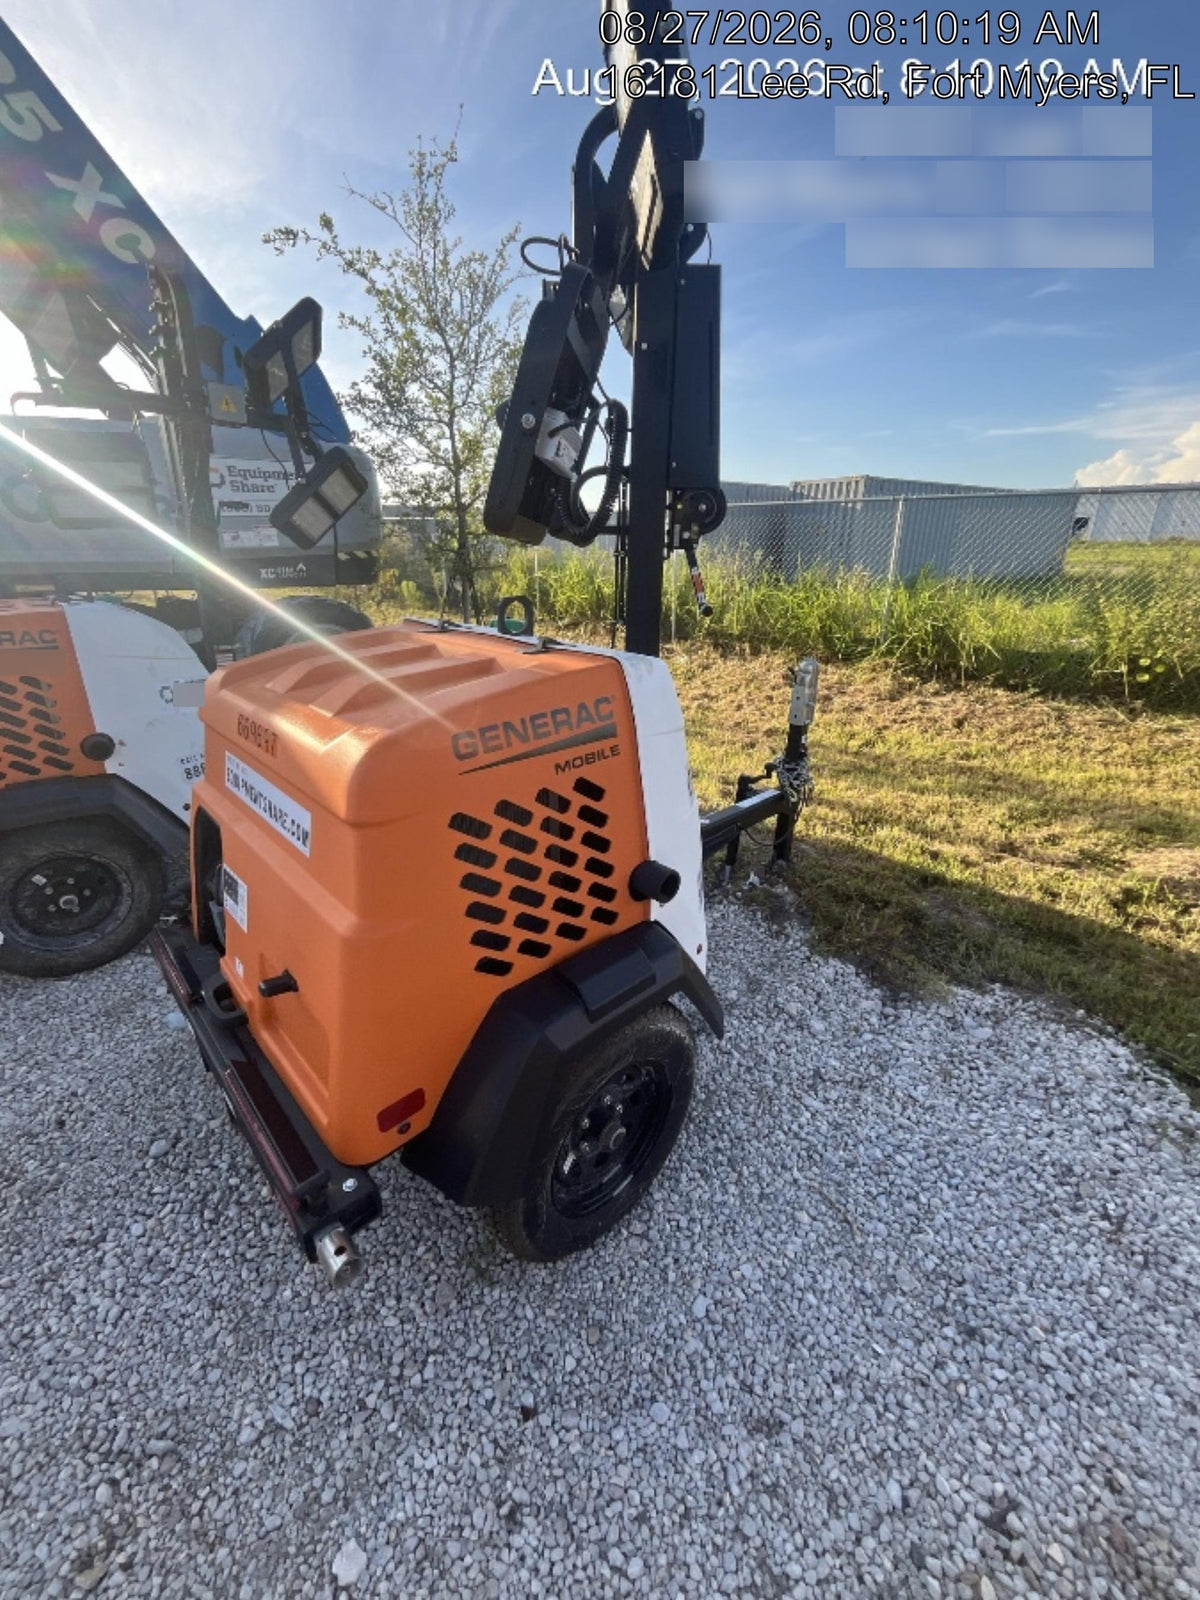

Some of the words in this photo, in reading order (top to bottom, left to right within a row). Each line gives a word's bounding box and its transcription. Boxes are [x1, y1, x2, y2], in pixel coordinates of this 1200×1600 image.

[229, 479, 276, 493] Share
[451, 696, 615, 762] GENERAC
[553, 744, 621, 775] MOBILE
